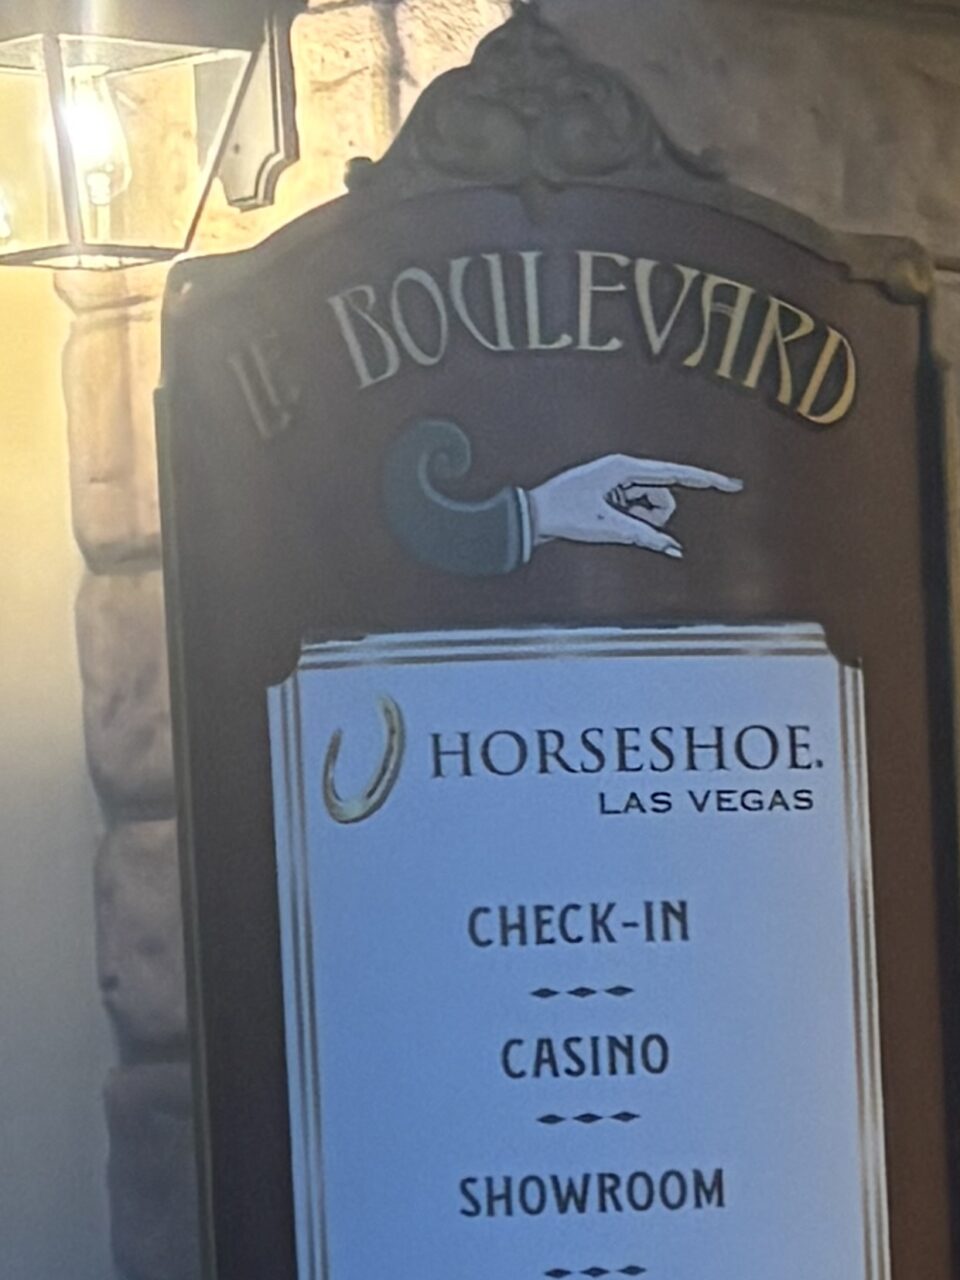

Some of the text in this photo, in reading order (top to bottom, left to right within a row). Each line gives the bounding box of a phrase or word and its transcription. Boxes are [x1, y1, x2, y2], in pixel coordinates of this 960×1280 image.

[326, 249, 859, 426] BOULEVARD
[598, 789, 814, 815] LAS VEGAS
[468, 900, 689, 948] CHECK-IN
[501, 1033, 669, 1079] CASINO
[459, 1168, 725, 1218] SHOWROOM
